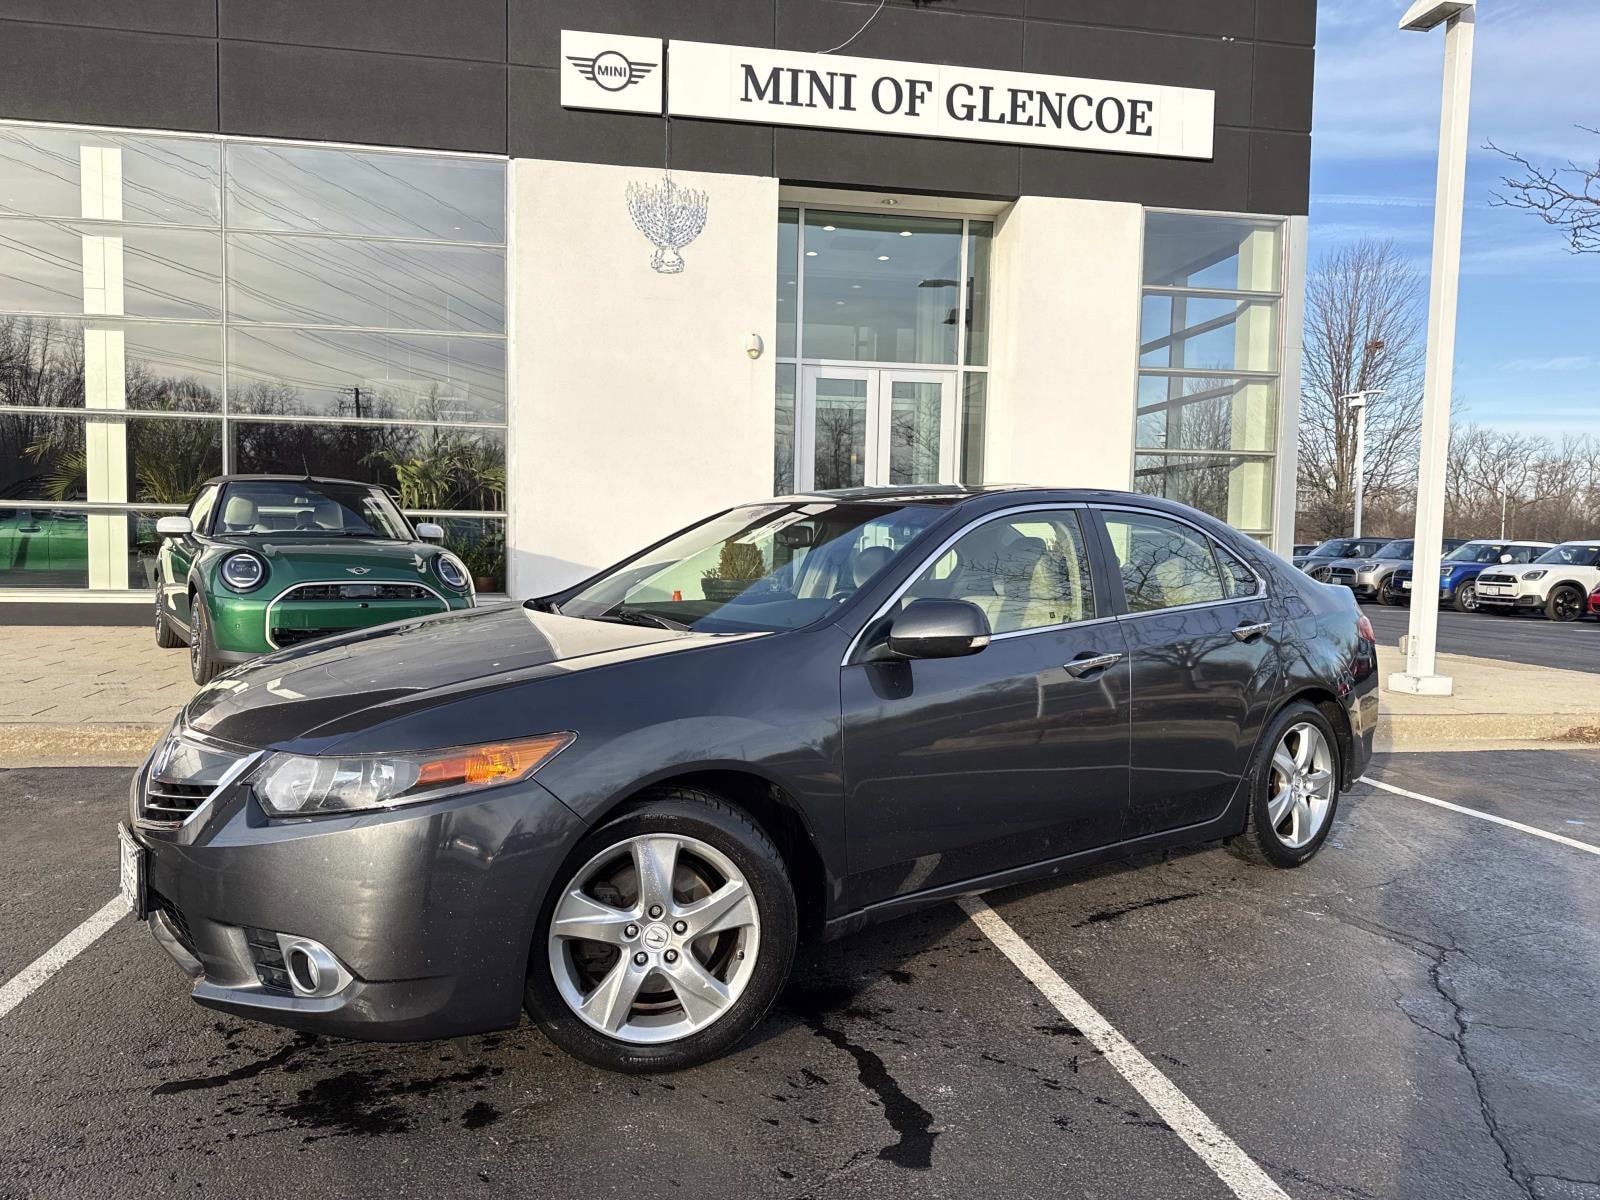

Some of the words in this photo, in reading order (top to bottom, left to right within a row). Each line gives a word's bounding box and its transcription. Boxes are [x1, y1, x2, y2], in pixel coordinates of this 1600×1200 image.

[597, 65, 627, 77] MINI
[740, 63, 857, 112] MINI
[871, 76, 933, 117] OF
[945, 83, 1153, 137] GLENCOE
